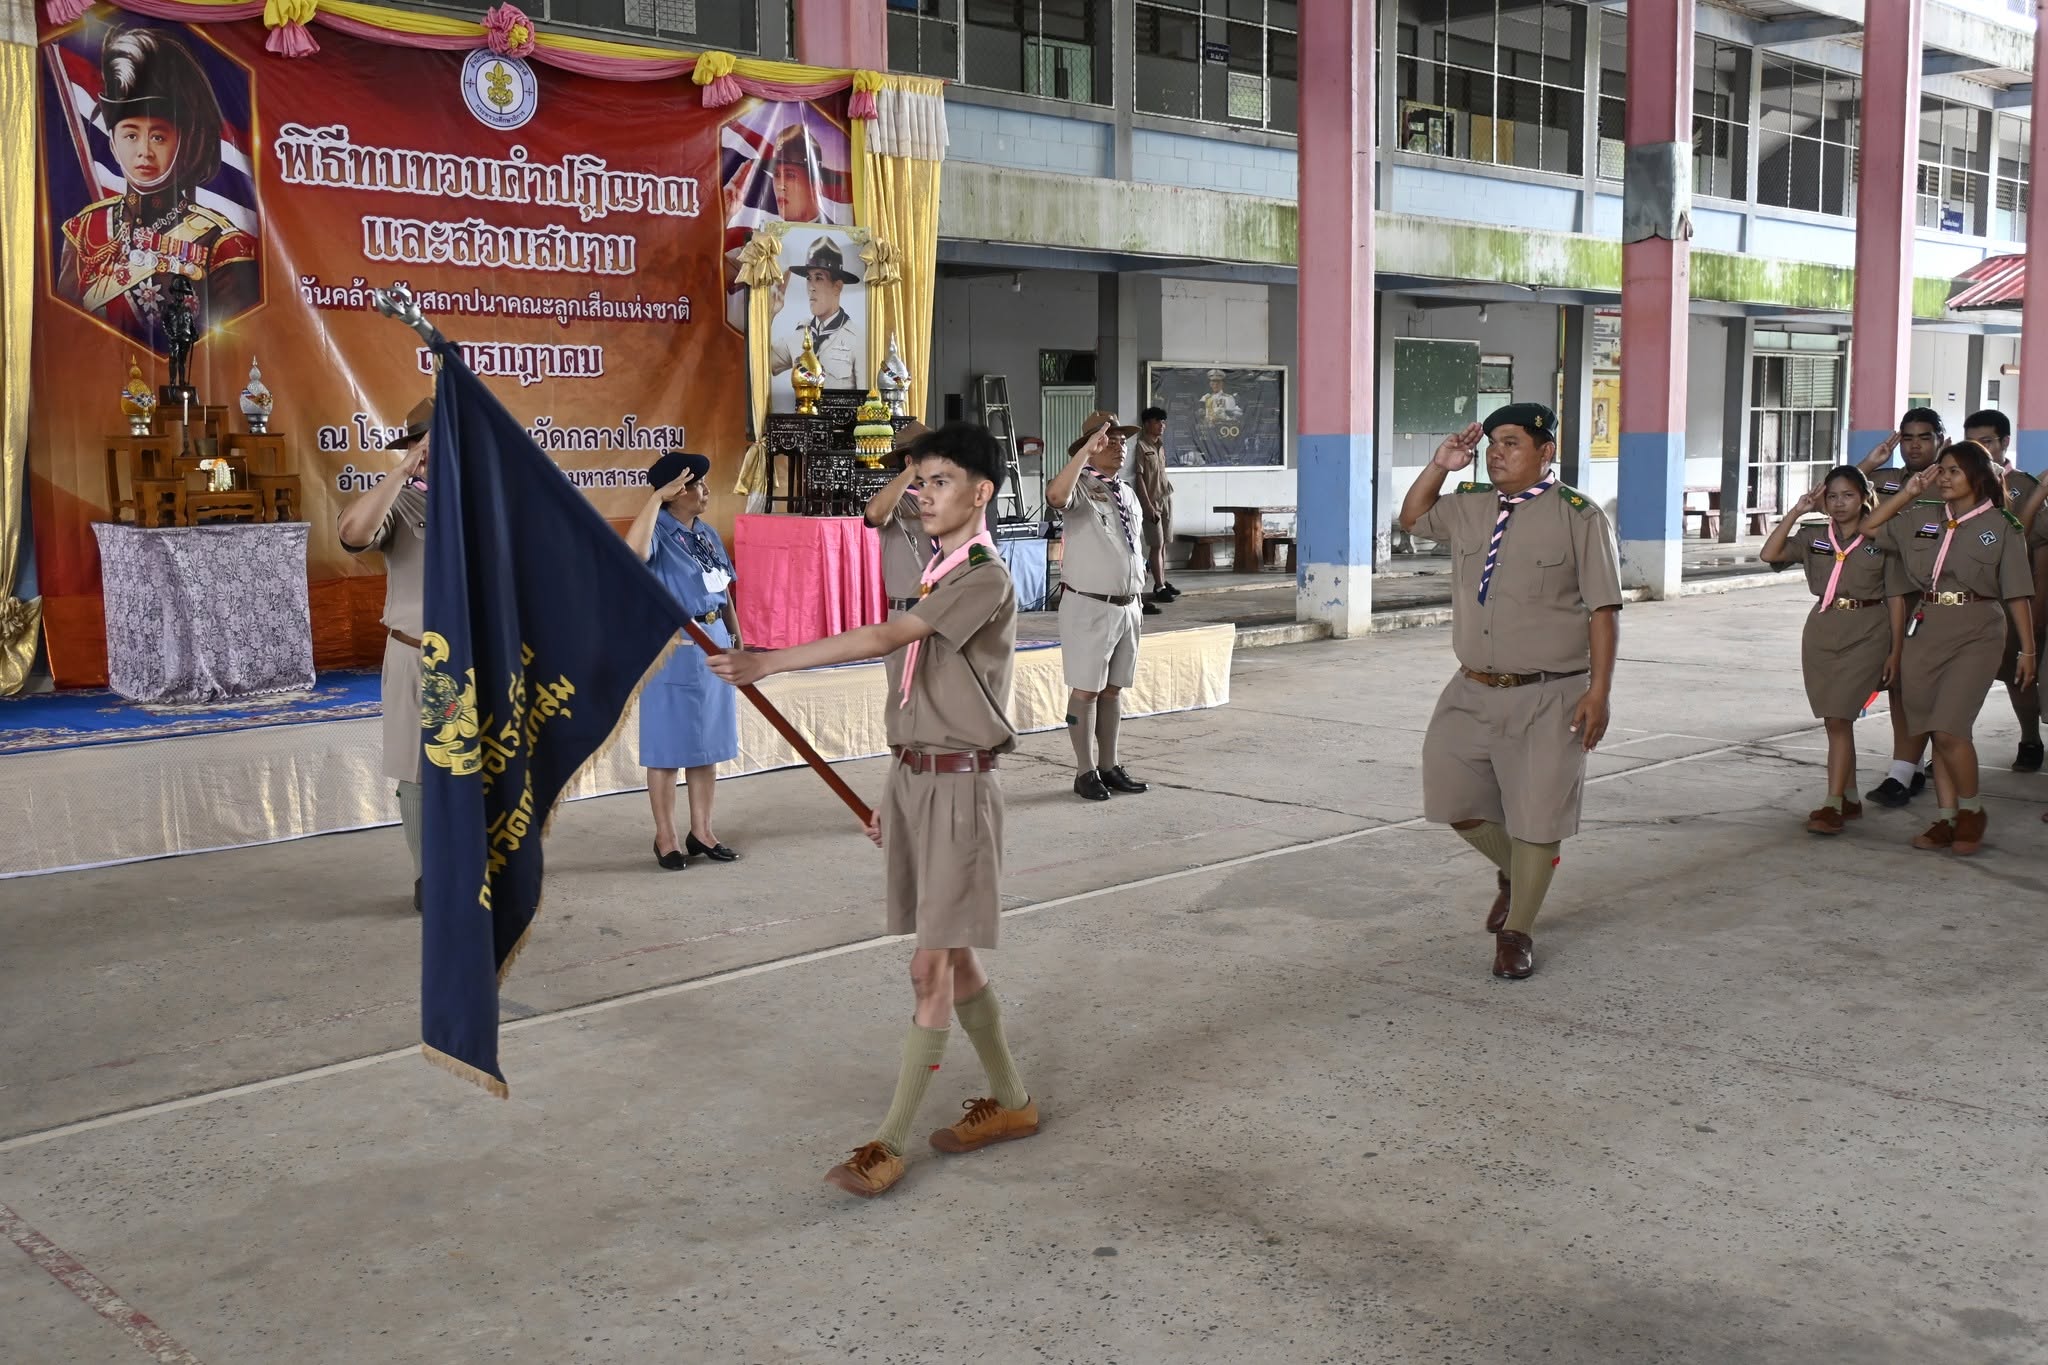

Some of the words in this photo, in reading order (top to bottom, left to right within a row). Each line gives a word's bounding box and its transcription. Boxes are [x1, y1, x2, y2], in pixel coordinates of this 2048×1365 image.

[275, 122, 700, 221] พิธีทบทวนคำปฏิญาณ
[361, 215, 636, 274] และสวนสนาม
[300, 276, 691, 325] วันคล้าันสถาปนาคณะลูกเสือแห่งชาติ
[318, 426, 348, 450] ณ
